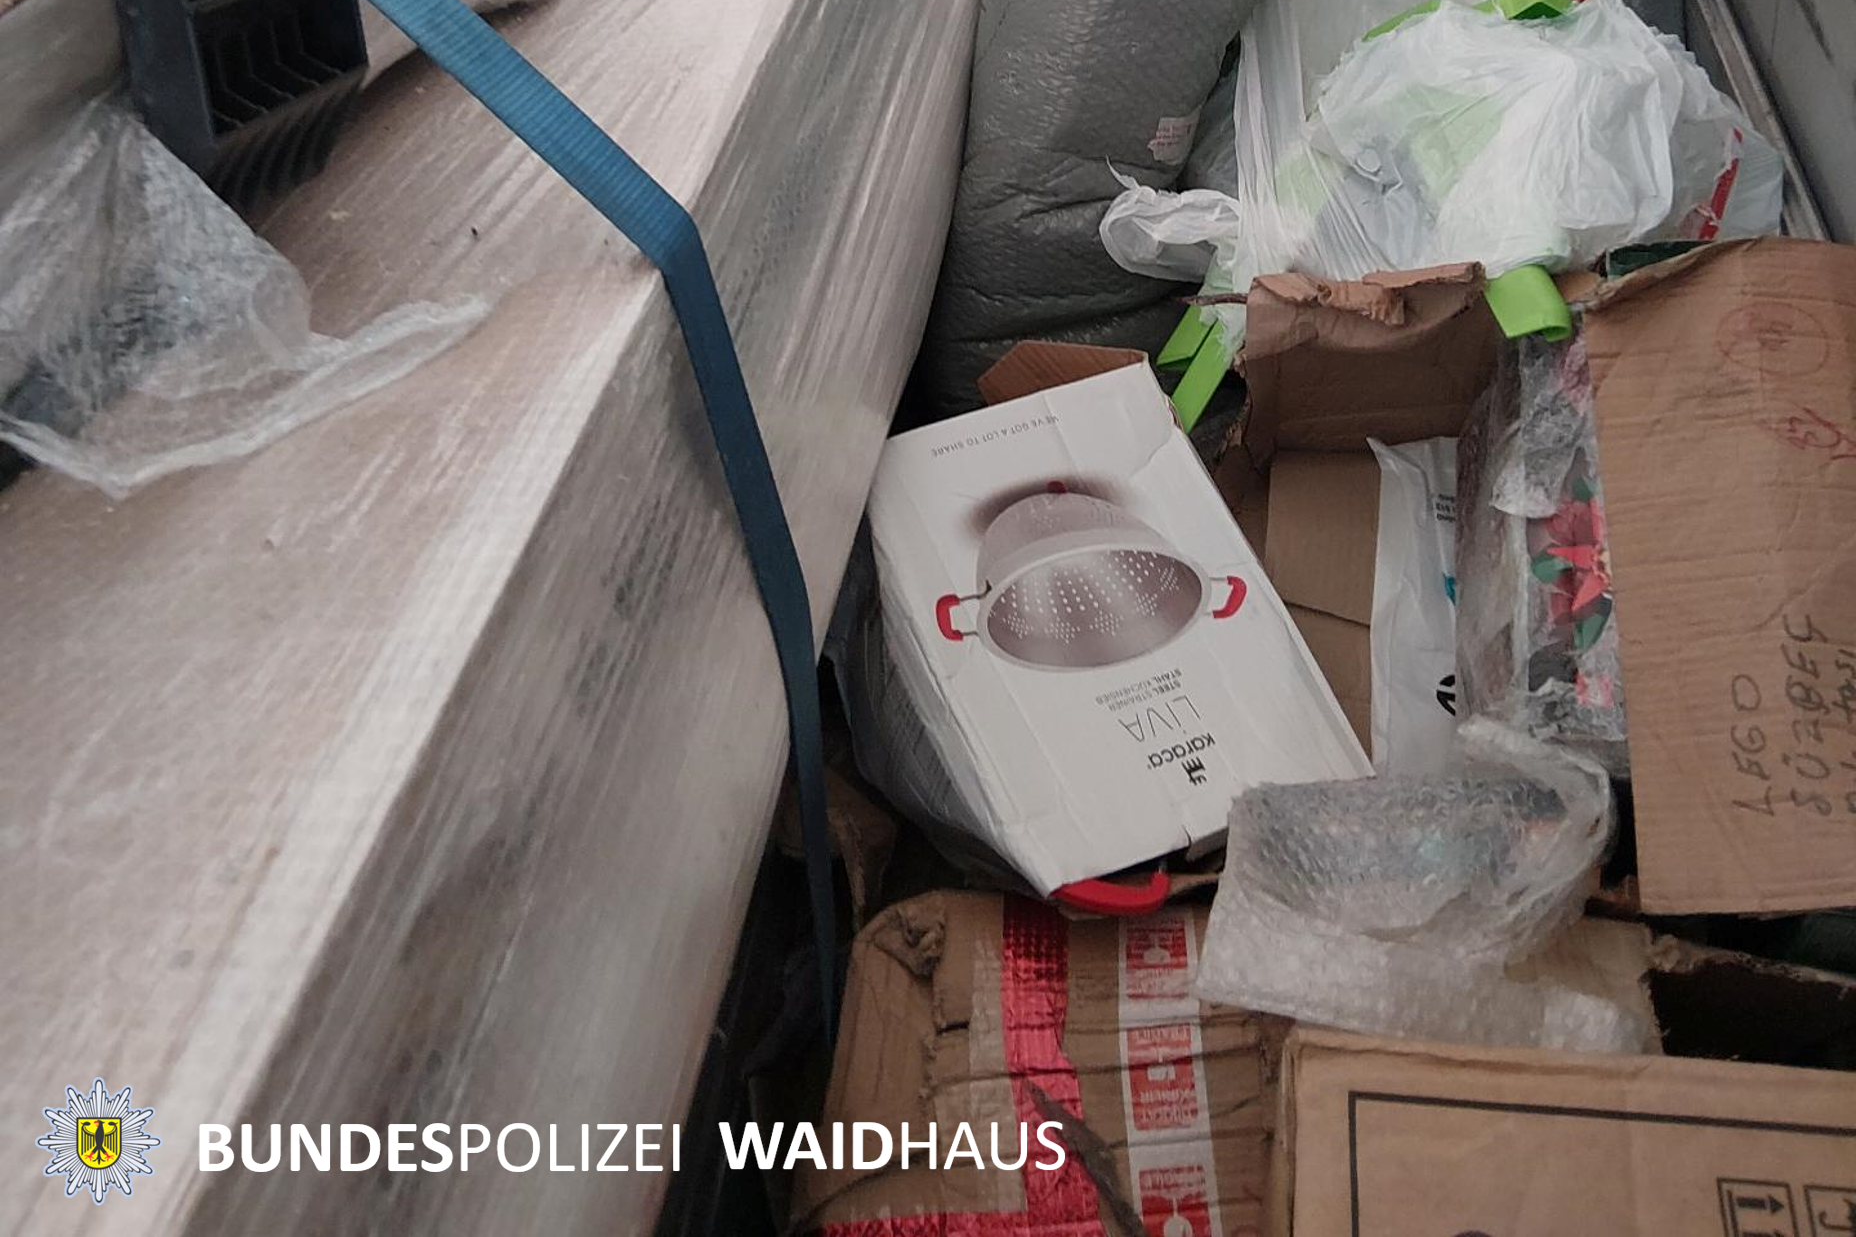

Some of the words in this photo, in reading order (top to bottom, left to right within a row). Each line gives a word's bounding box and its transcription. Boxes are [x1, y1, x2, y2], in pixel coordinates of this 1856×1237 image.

[1010, 422, 1029, 434] GOT
[966, 437, 978, 446] TO
[982, 431, 999, 443] LOT
[930, 441, 964, 457] SHARE
[1153, 668, 1182, 683] STAHL
[1152, 680, 1182, 696] STEEL
[1107, 691, 1152, 712] STRAINER
[1147, 733, 1216, 770] karaca
